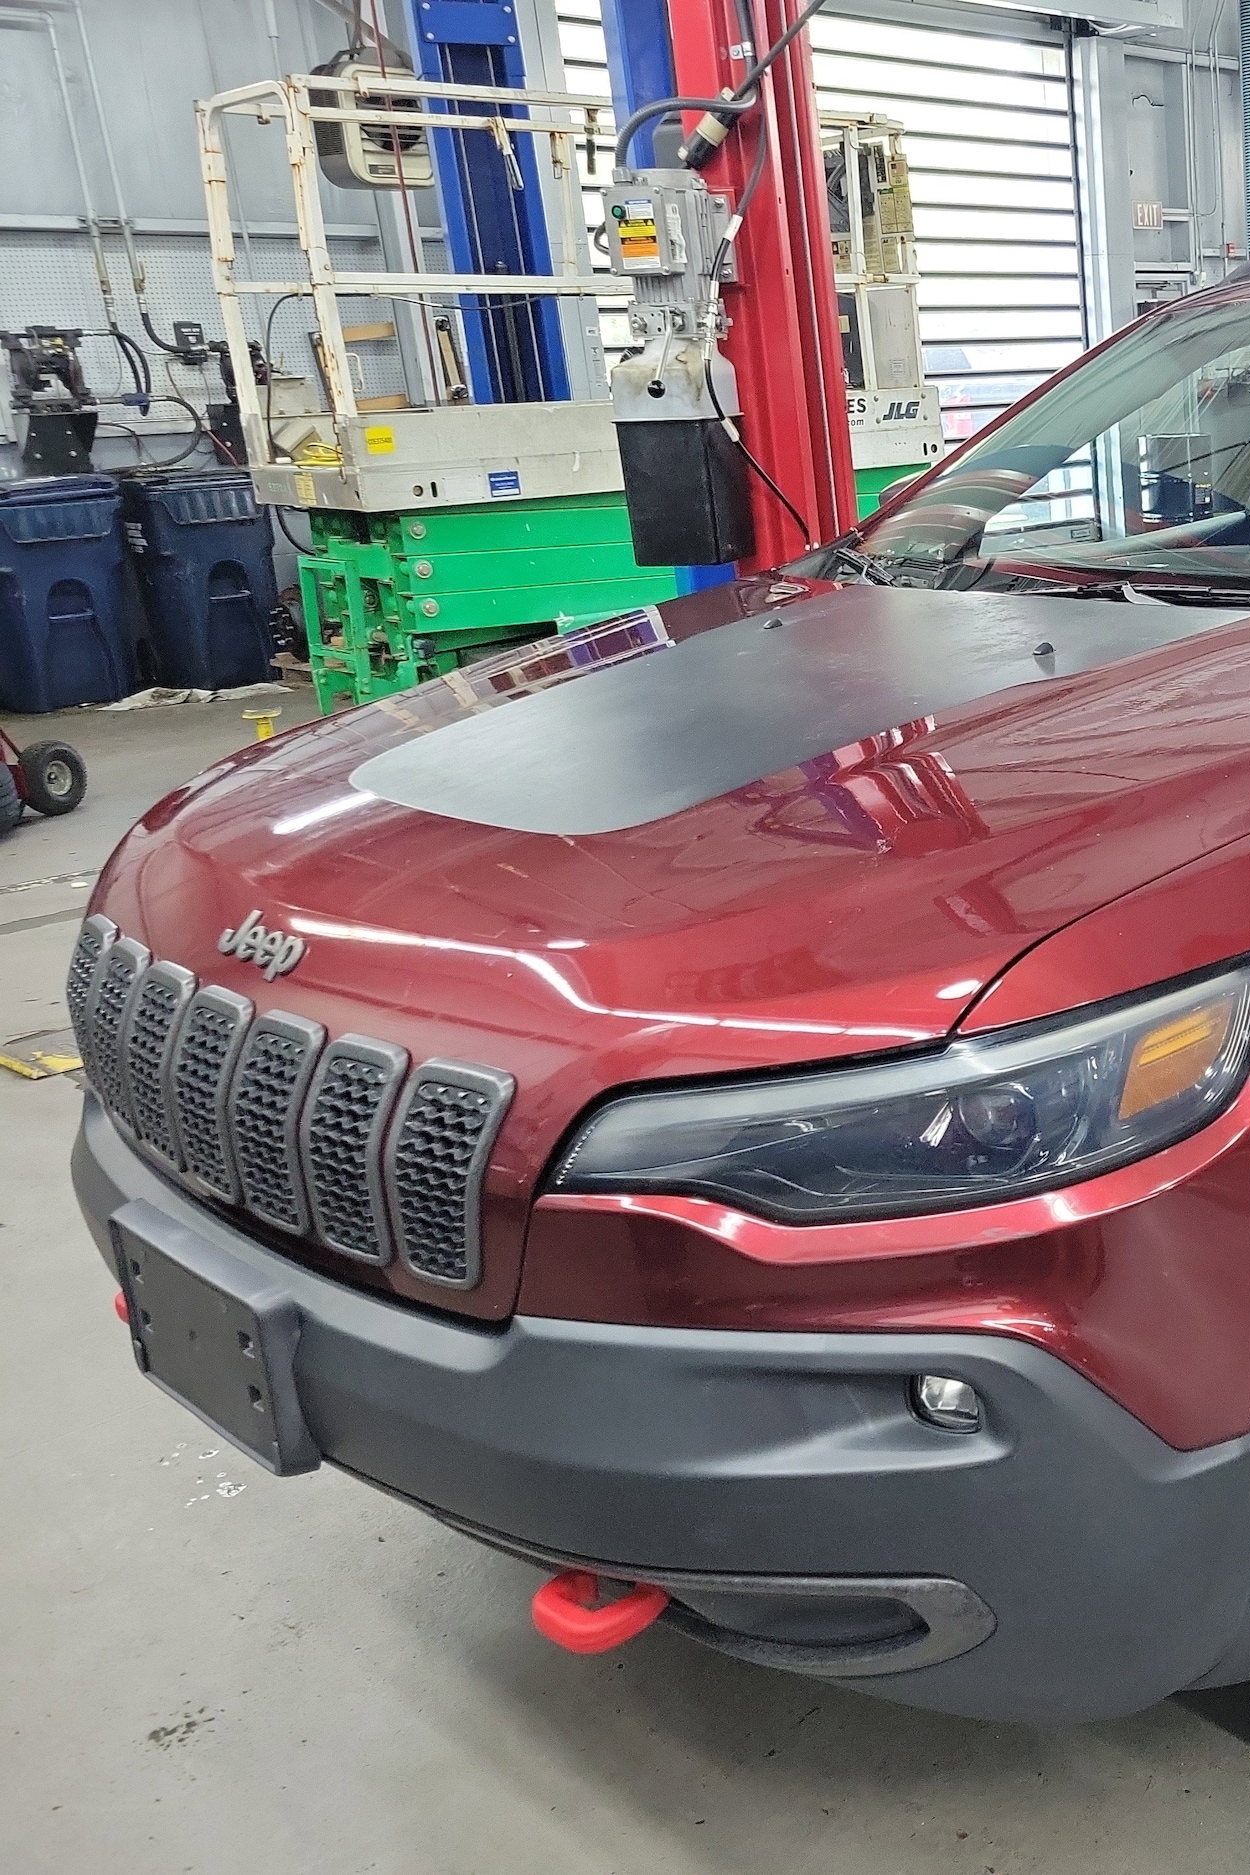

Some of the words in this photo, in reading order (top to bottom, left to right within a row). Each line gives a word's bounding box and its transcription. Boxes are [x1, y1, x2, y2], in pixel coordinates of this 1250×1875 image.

[1137, 203, 1158, 226] EXIT
[882, 401, 920, 421] JLG
[217, 909, 306, 983] Jeep
